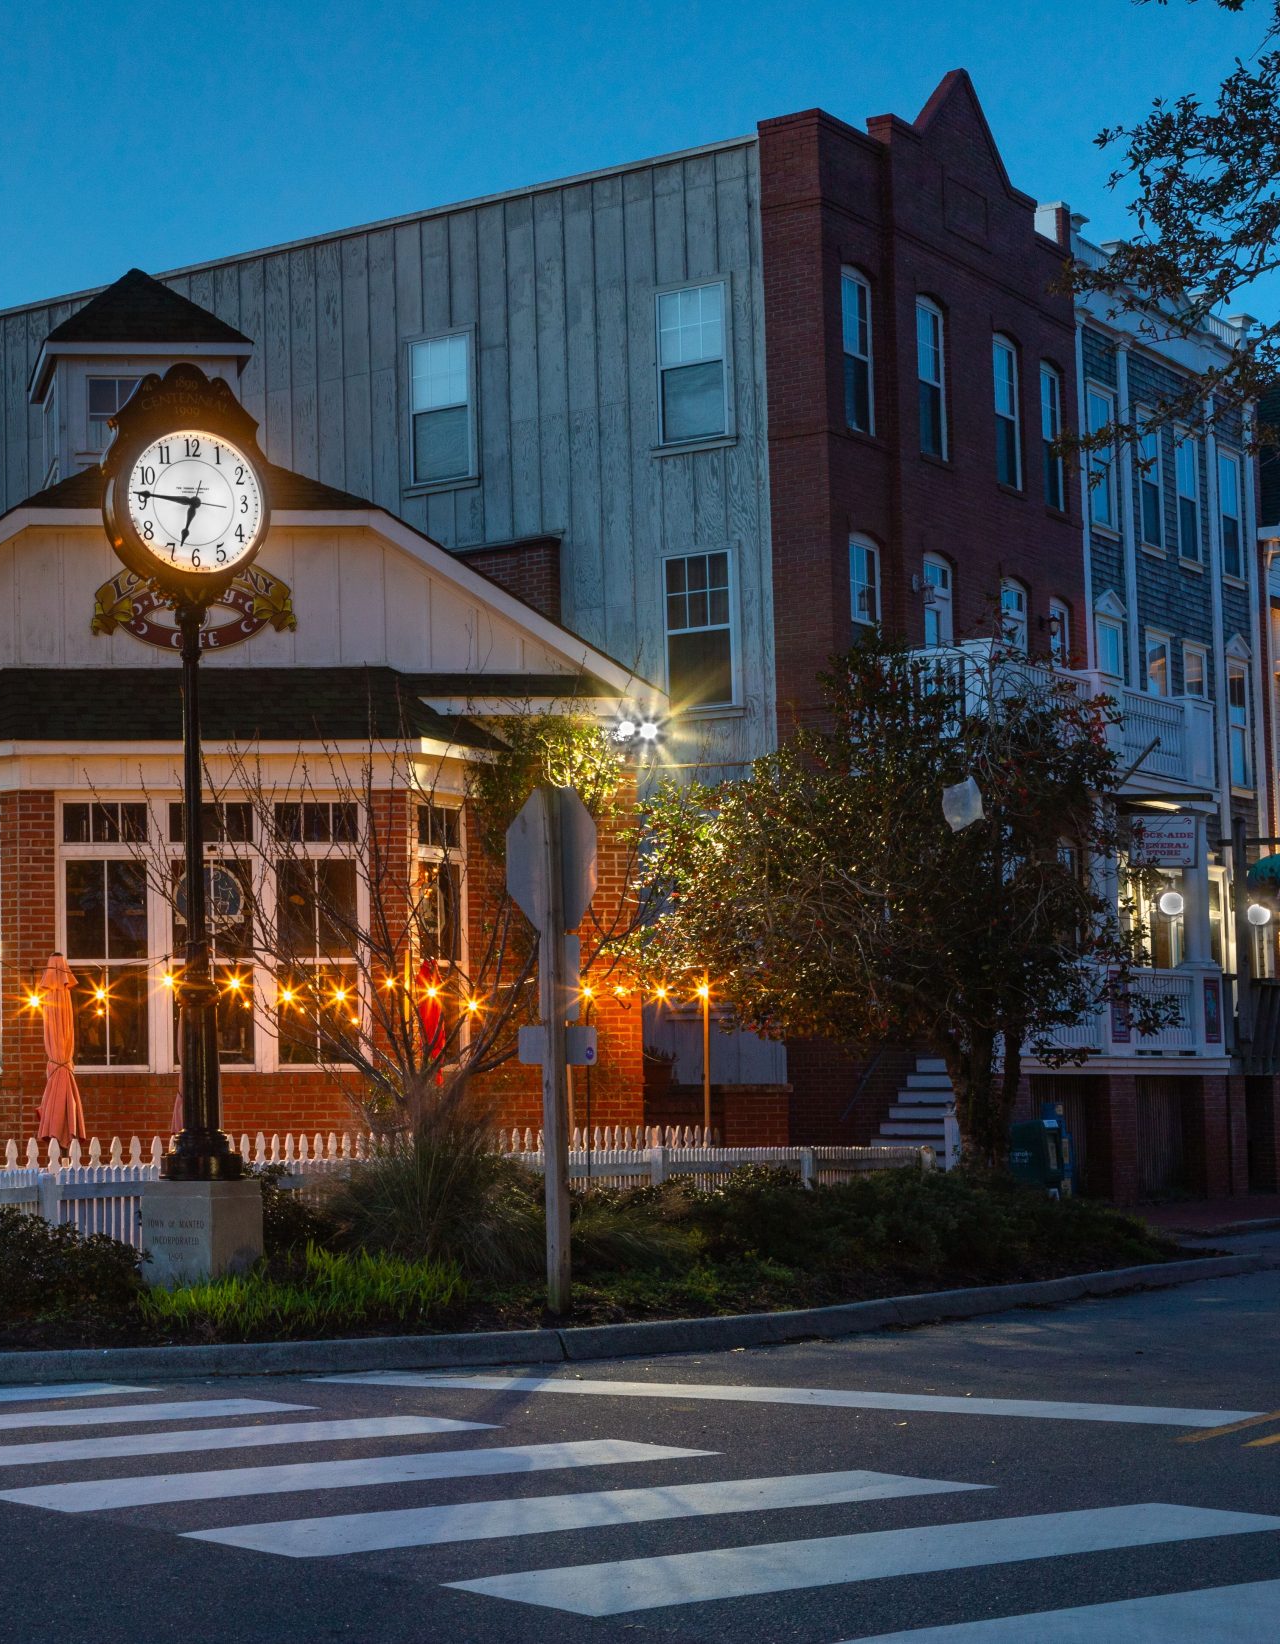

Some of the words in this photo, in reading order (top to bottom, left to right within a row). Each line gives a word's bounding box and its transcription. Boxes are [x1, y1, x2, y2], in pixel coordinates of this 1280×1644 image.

[175, 376, 198, 391] 1899
[158, 446, 171, 464] 11
[185, 439, 202, 458] 12
[214, 446, 221, 465] 1
[140, 466, 156, 485] 10
[234, 466, 245, 485] 2
[138, 493, 148, 510] 9
[240, 495, 249, 514] 3
[143, 521, 154, 540] 8
[234, 523, 245, 543] 4
[165, 543, 176, 562] 7
[191, 549, 201, 568] 6
[216, 542, 227, 563] 5
[171, 631, 220, 648] CFE
